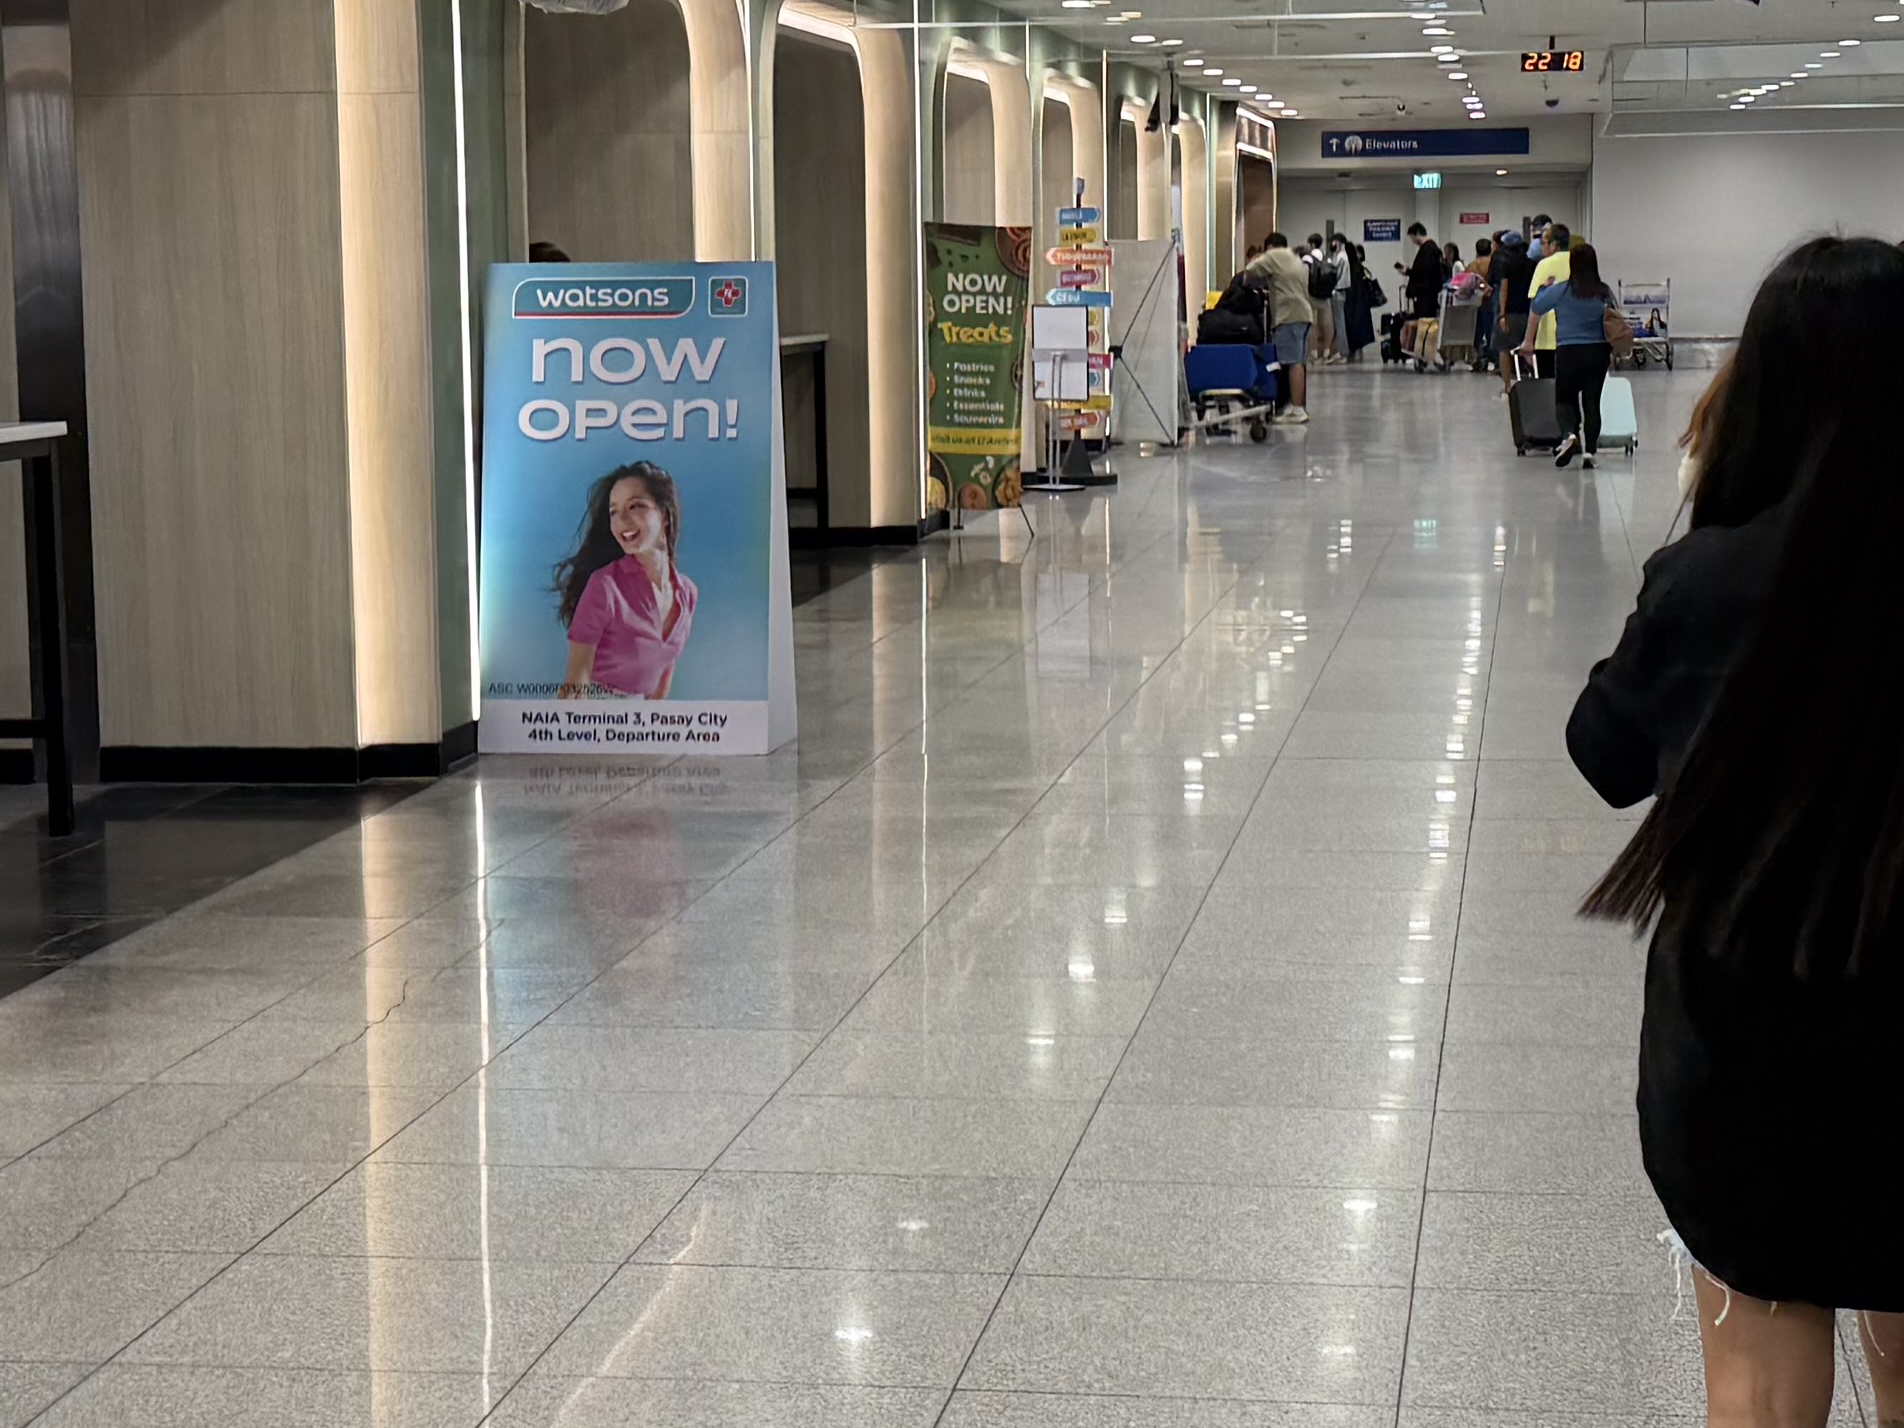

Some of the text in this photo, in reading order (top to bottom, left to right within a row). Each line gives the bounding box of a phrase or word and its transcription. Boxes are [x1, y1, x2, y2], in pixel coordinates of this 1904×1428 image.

[1524, 51, 1582, 70] 22 18
[1365, 138, 1418, 150] Elevators
[947, 272, 1007, 292] NOW
[536, 285, 669, 308] watsons
[943, 294, 1013, 315] OPEN!
[937, 321, 1014, 344] Treats
[522, 712, 728, 728] NAIA Terminal 3, Pasay City
[528, 728, 720, 744] 4th Level, Departure Area
